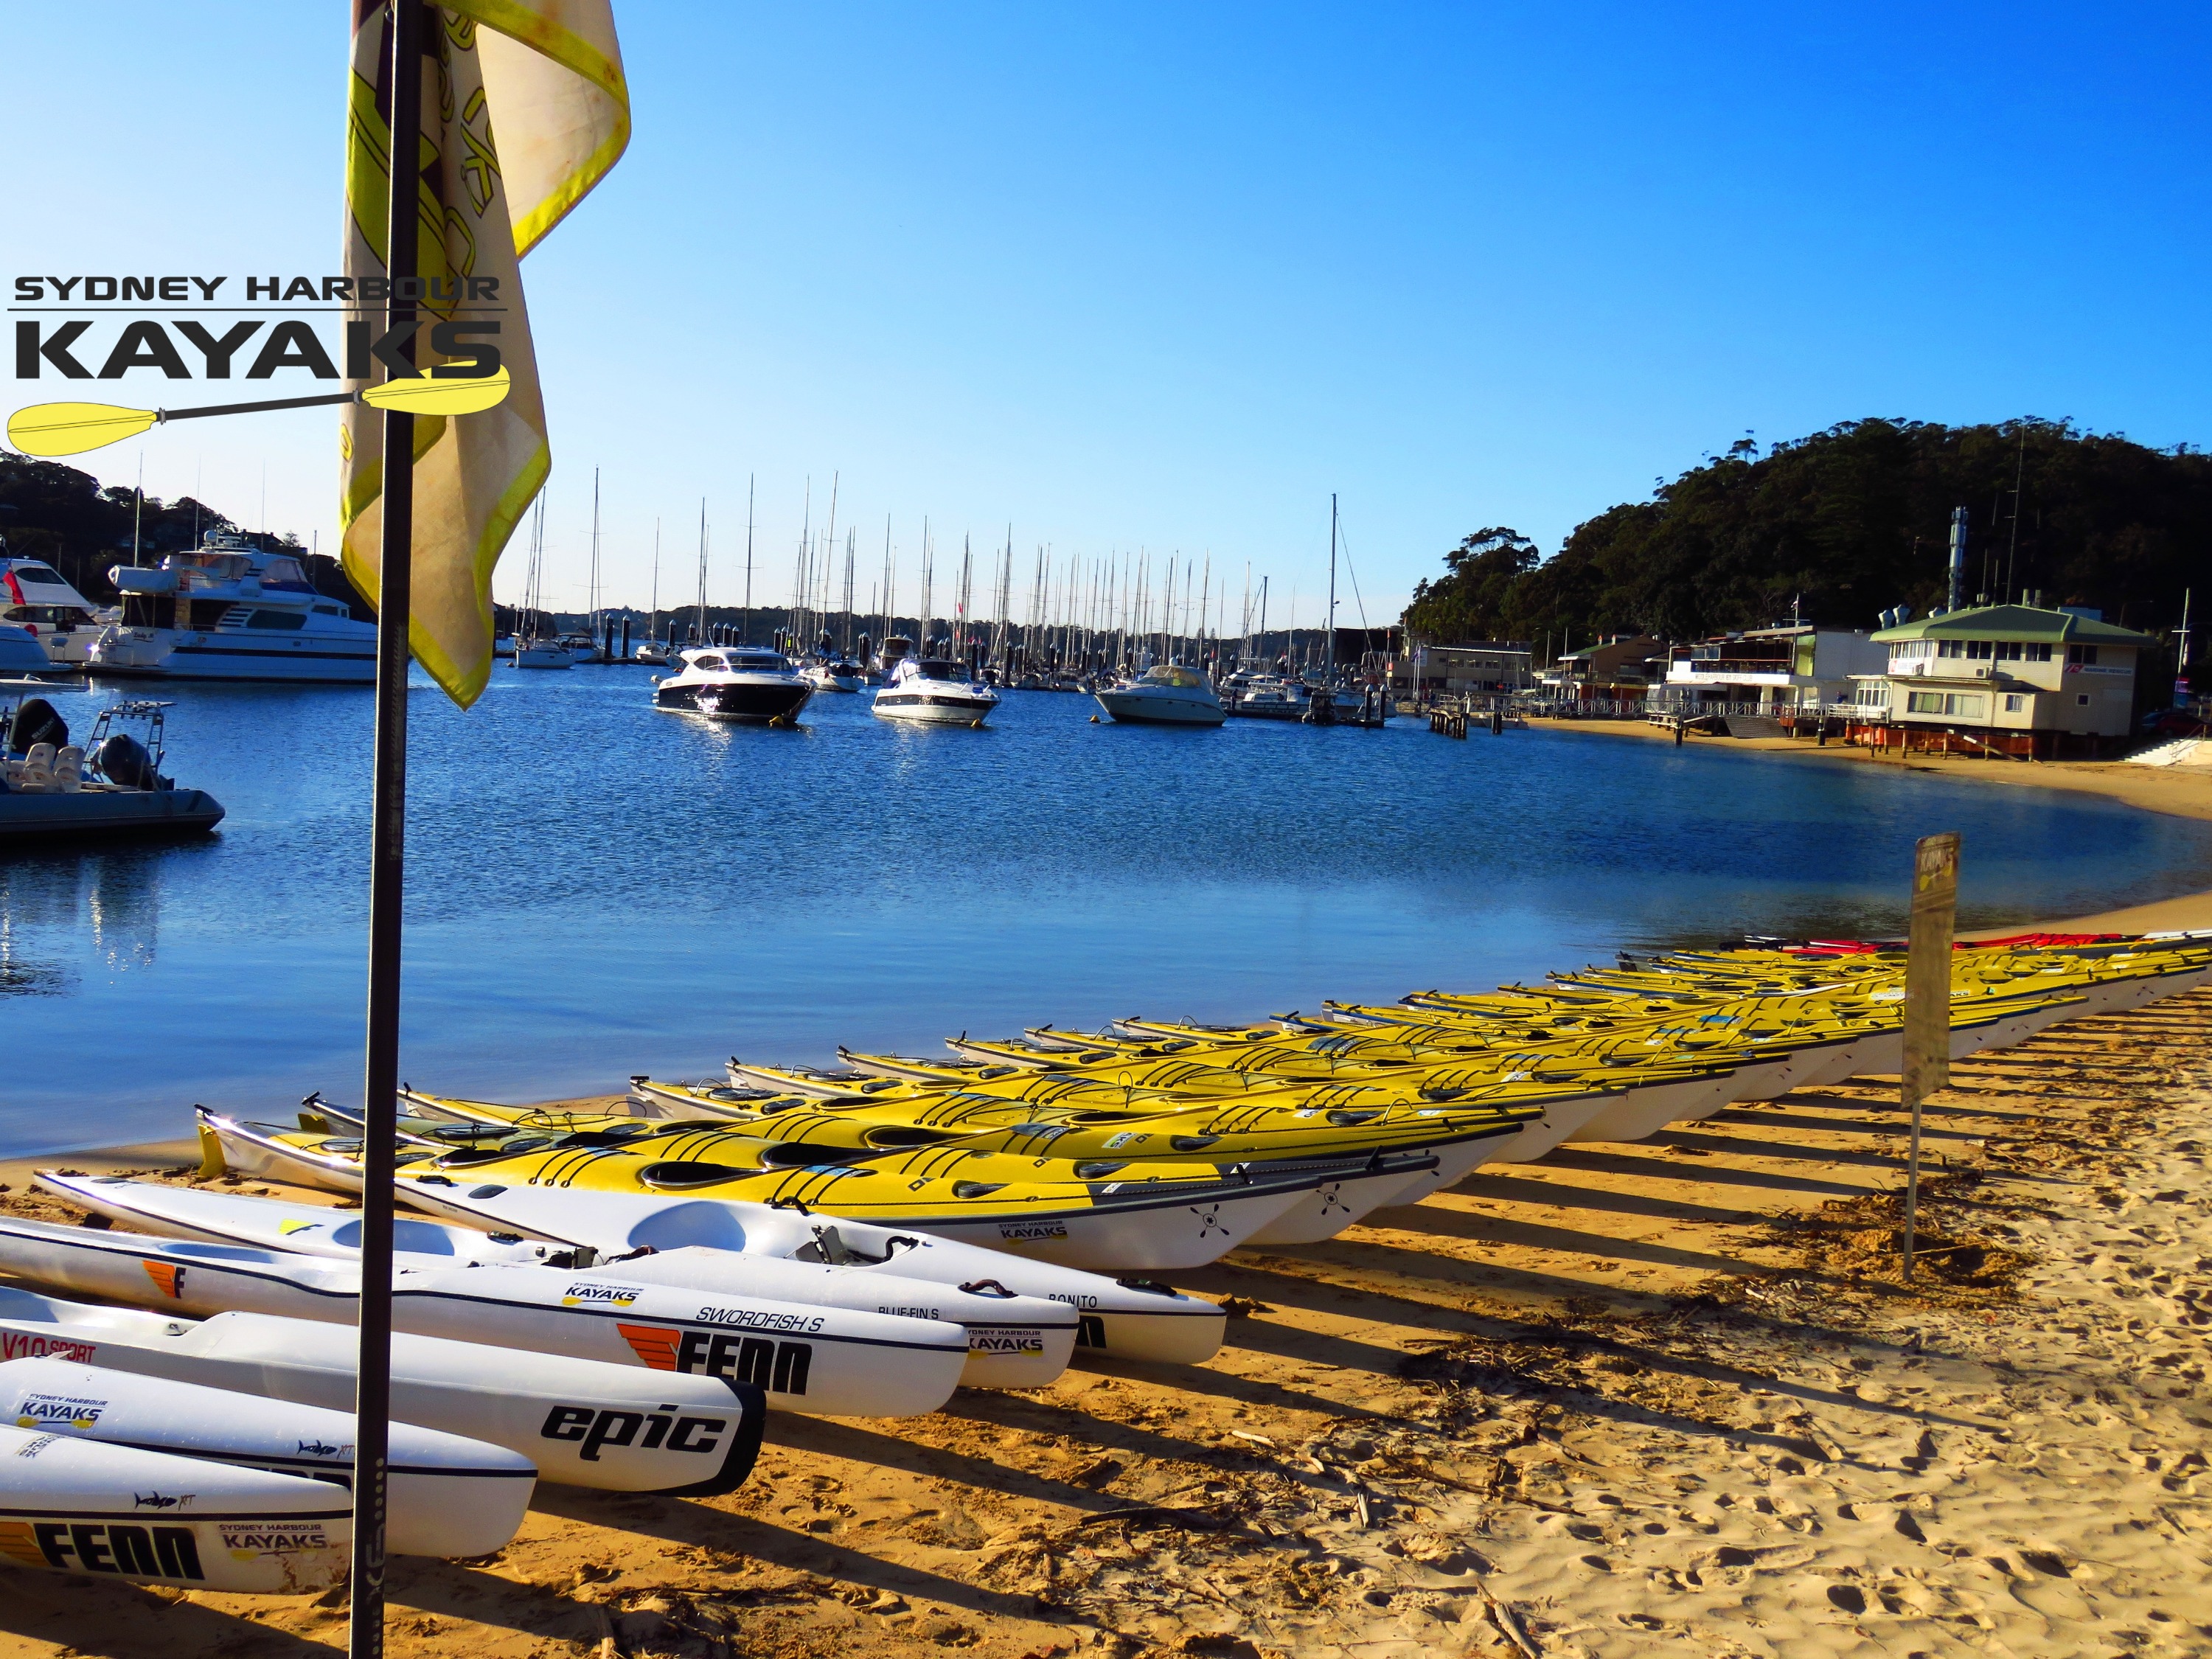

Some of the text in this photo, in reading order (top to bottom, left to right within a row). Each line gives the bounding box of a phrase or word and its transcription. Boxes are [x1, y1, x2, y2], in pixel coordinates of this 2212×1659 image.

[32, 717, 55, 740] SUZUKI
[1001, 1226, 1068, 1239] KAYAKS
[565, 1287, 640, 1301] KAYAKS
[695, 1307, 825, 1332] SWORDFISH S
[931, 1308, 939, 1320] S
[2, 1332, 46, 1360] V10
[970, 1338, 1043, 1352] KAYAKS
[29, 1393, 108, 1407] SYDNEY HARBOUR
[20, 1402, 102, 1422] KAYAKS
[540, 1403, 727, 1461] epic
[219, 1523, 322, 1531] SYDNEY HARBOUR
[223, 1534, 328, 1549] KAYAKS
